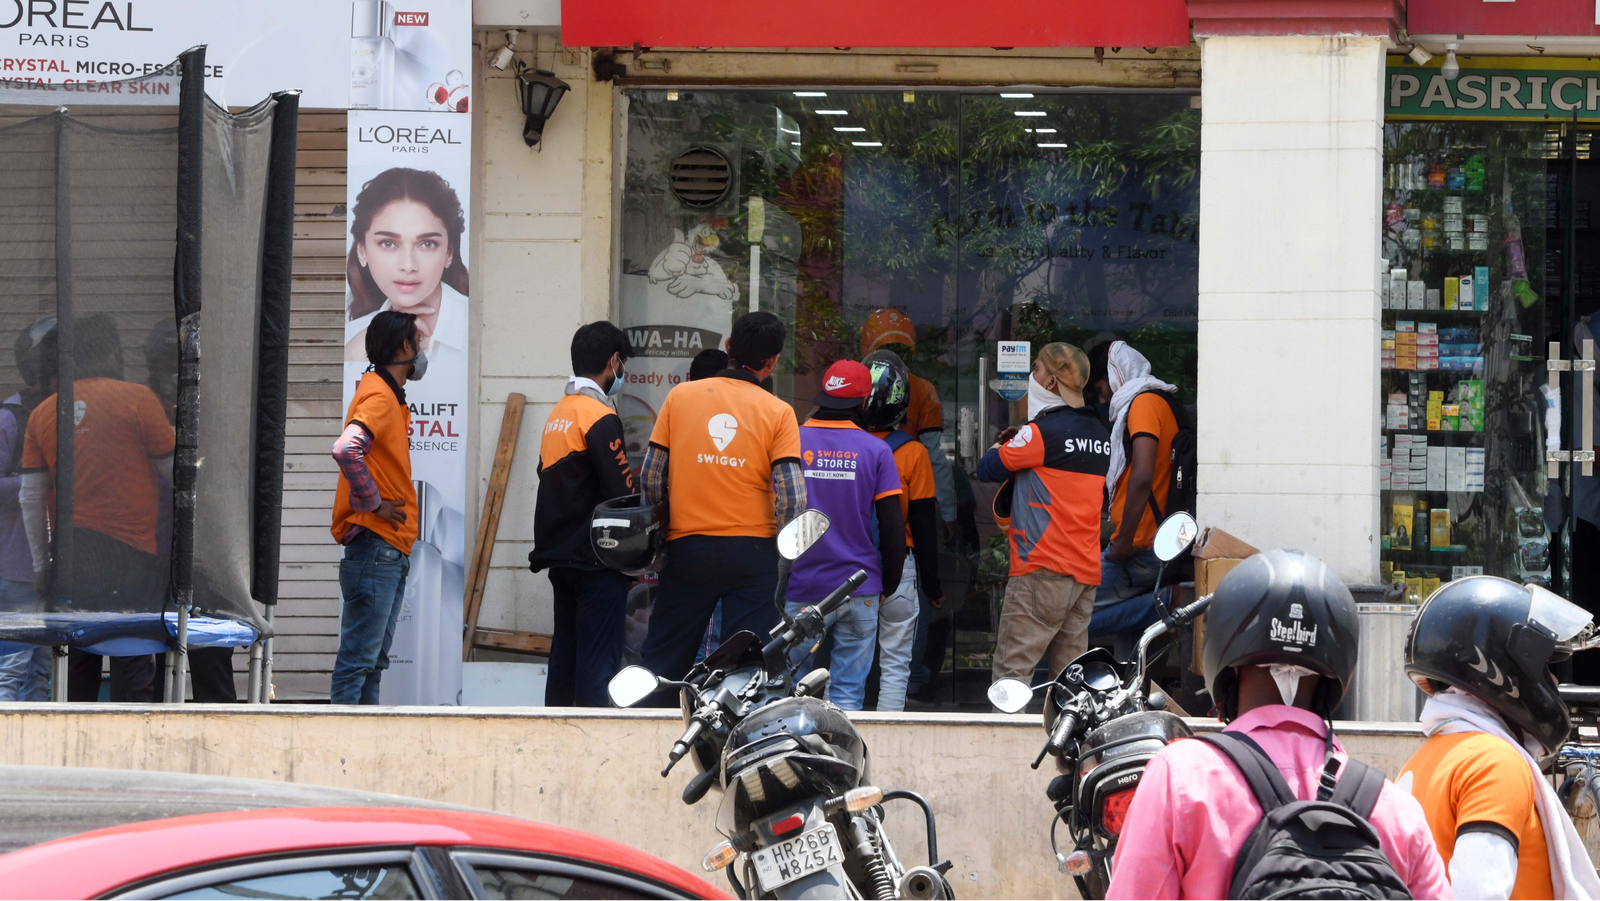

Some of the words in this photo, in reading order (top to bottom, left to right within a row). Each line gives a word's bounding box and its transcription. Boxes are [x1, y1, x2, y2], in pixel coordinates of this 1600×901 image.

[397, 14, 426, 24] NEW
[0, 58, 70, 73] RYSTAL
[0, 76, 57, 91] YSTAL
[63, 79, 122, 94] CLEAR
[128, 82, 170, 95] SKIN
[1389, 73, 1600, 111] PASRICH
[358, 125, 462, 144] L'ORÉAL
[1128, 201, 1199, 245] Tabl
[1102, 245, 1111, 259] &
[1118, 245, 1167, 259] Flavor
[627, 329, 703, 349] WA-HA
[624, 371, 664, 387] Ready
[668, 373, 681, 385] to
[829, 375, 846, 386] NIKE
[409, 403, 458, 416] ALIFT
[407, 420, 459, 437] STAL
[409, 441, 458, 452] SSENCE
[1064, 438, 1111, 456] SWIGG
[697, 453, 746, 468] SWIGGY
[817, 450, 859, 460] SWIGGY
[816, 459, 857, 470] STORES
[1270, 617, 1318, 645] Steelbird
[1117, 774, 1138, 785] Hero
[771, 829, 830, 864] HR26B
[762, 865, 772, 874] IND
[778, 845, 838, 881] W8454
